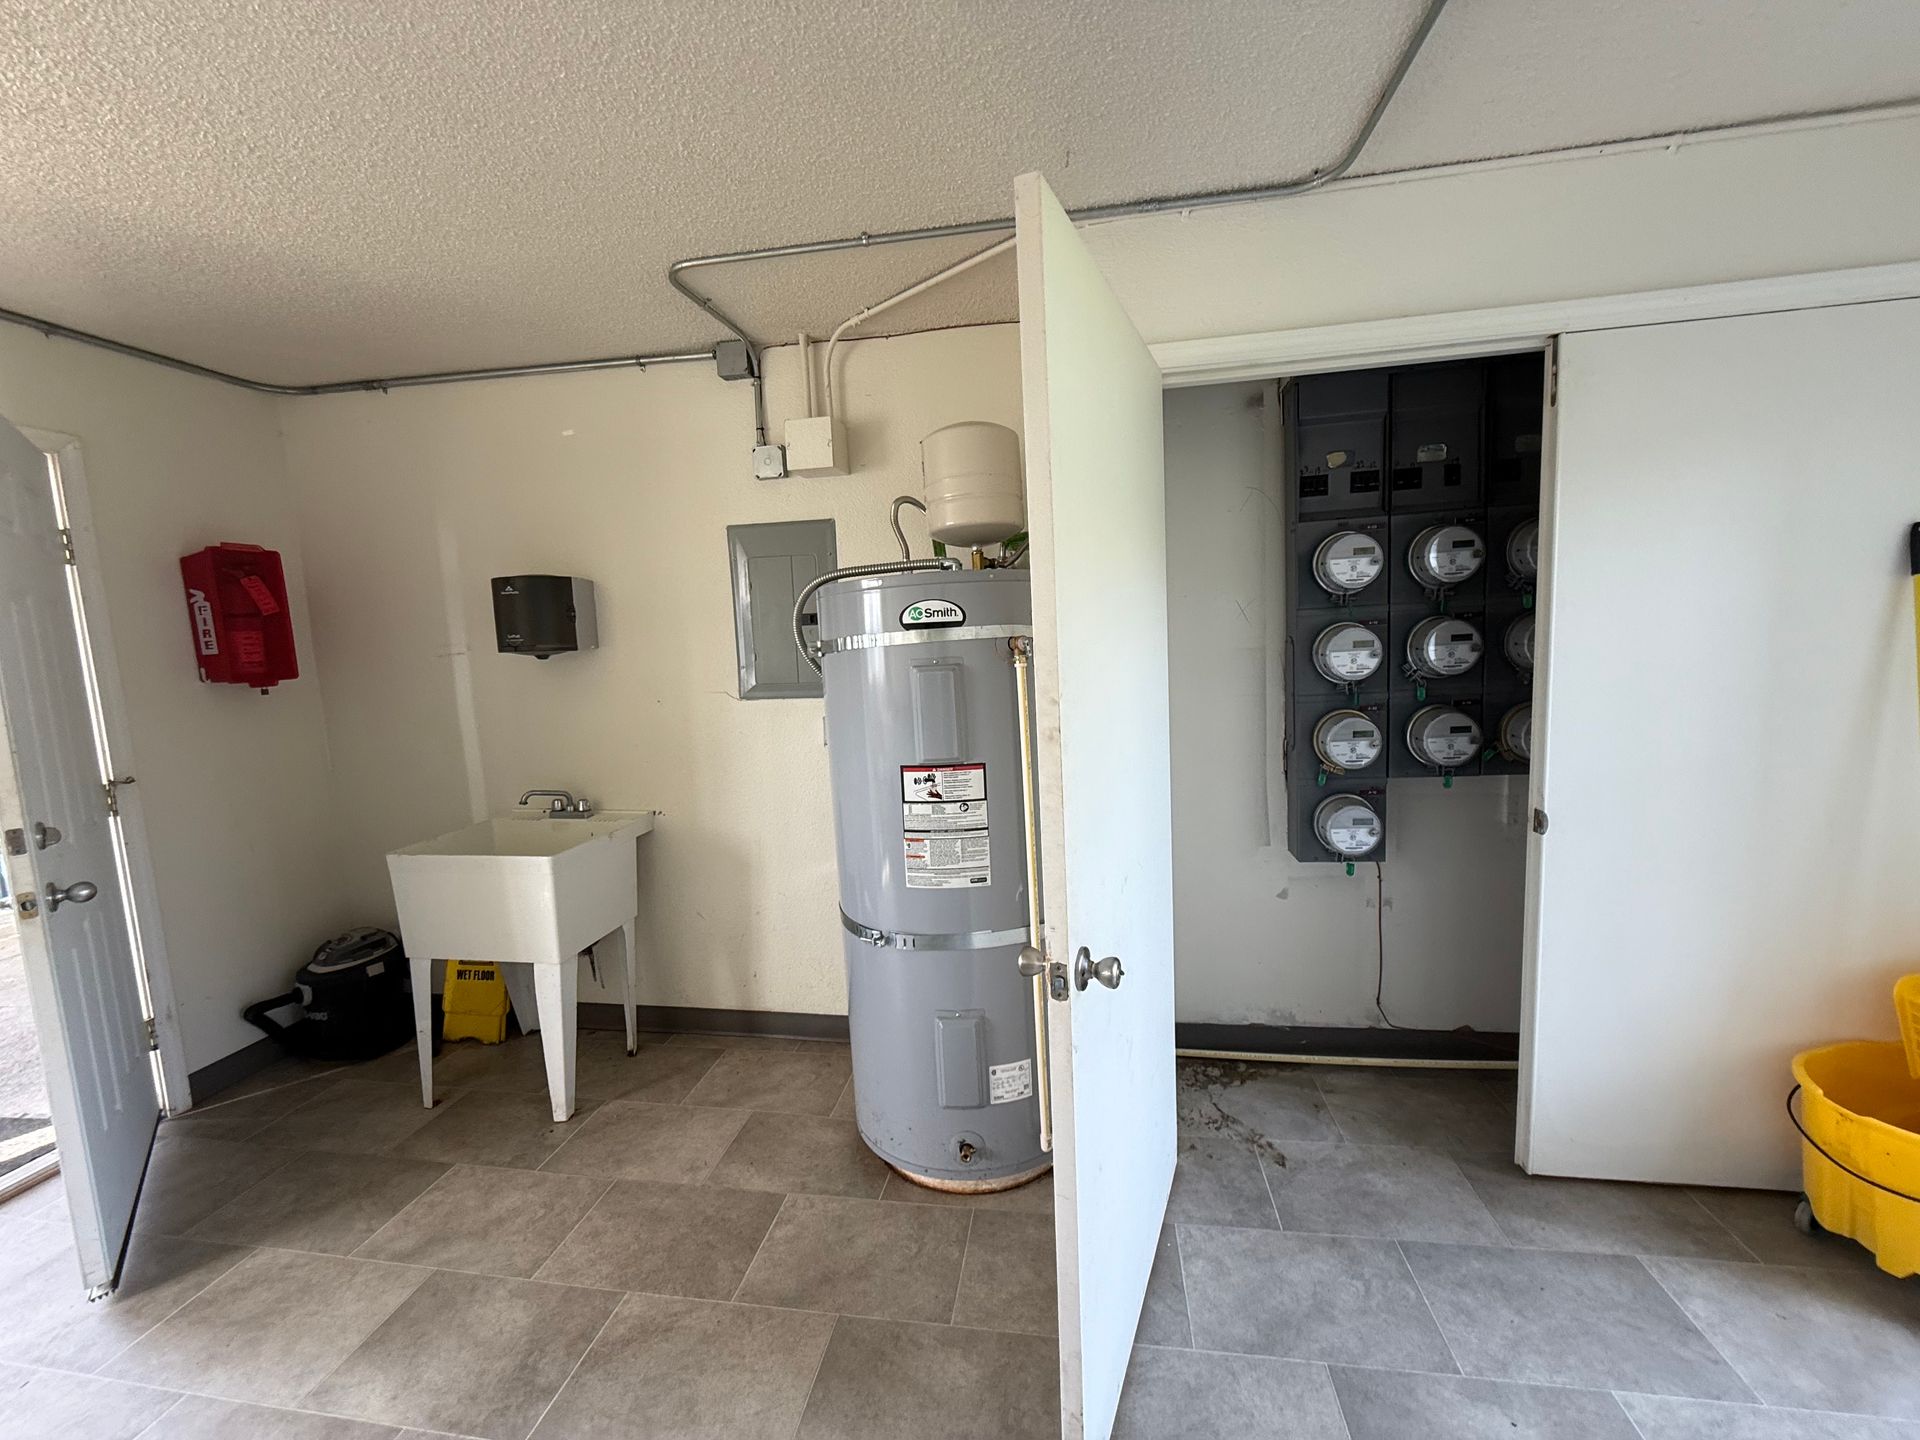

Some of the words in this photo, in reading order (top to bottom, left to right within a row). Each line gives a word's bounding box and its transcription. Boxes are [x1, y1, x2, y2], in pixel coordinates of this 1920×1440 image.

[198, 605, 213, 650] FIRE
[456, 969, 472, 981] WET
[473, 969, 495, 981] FLOOR
